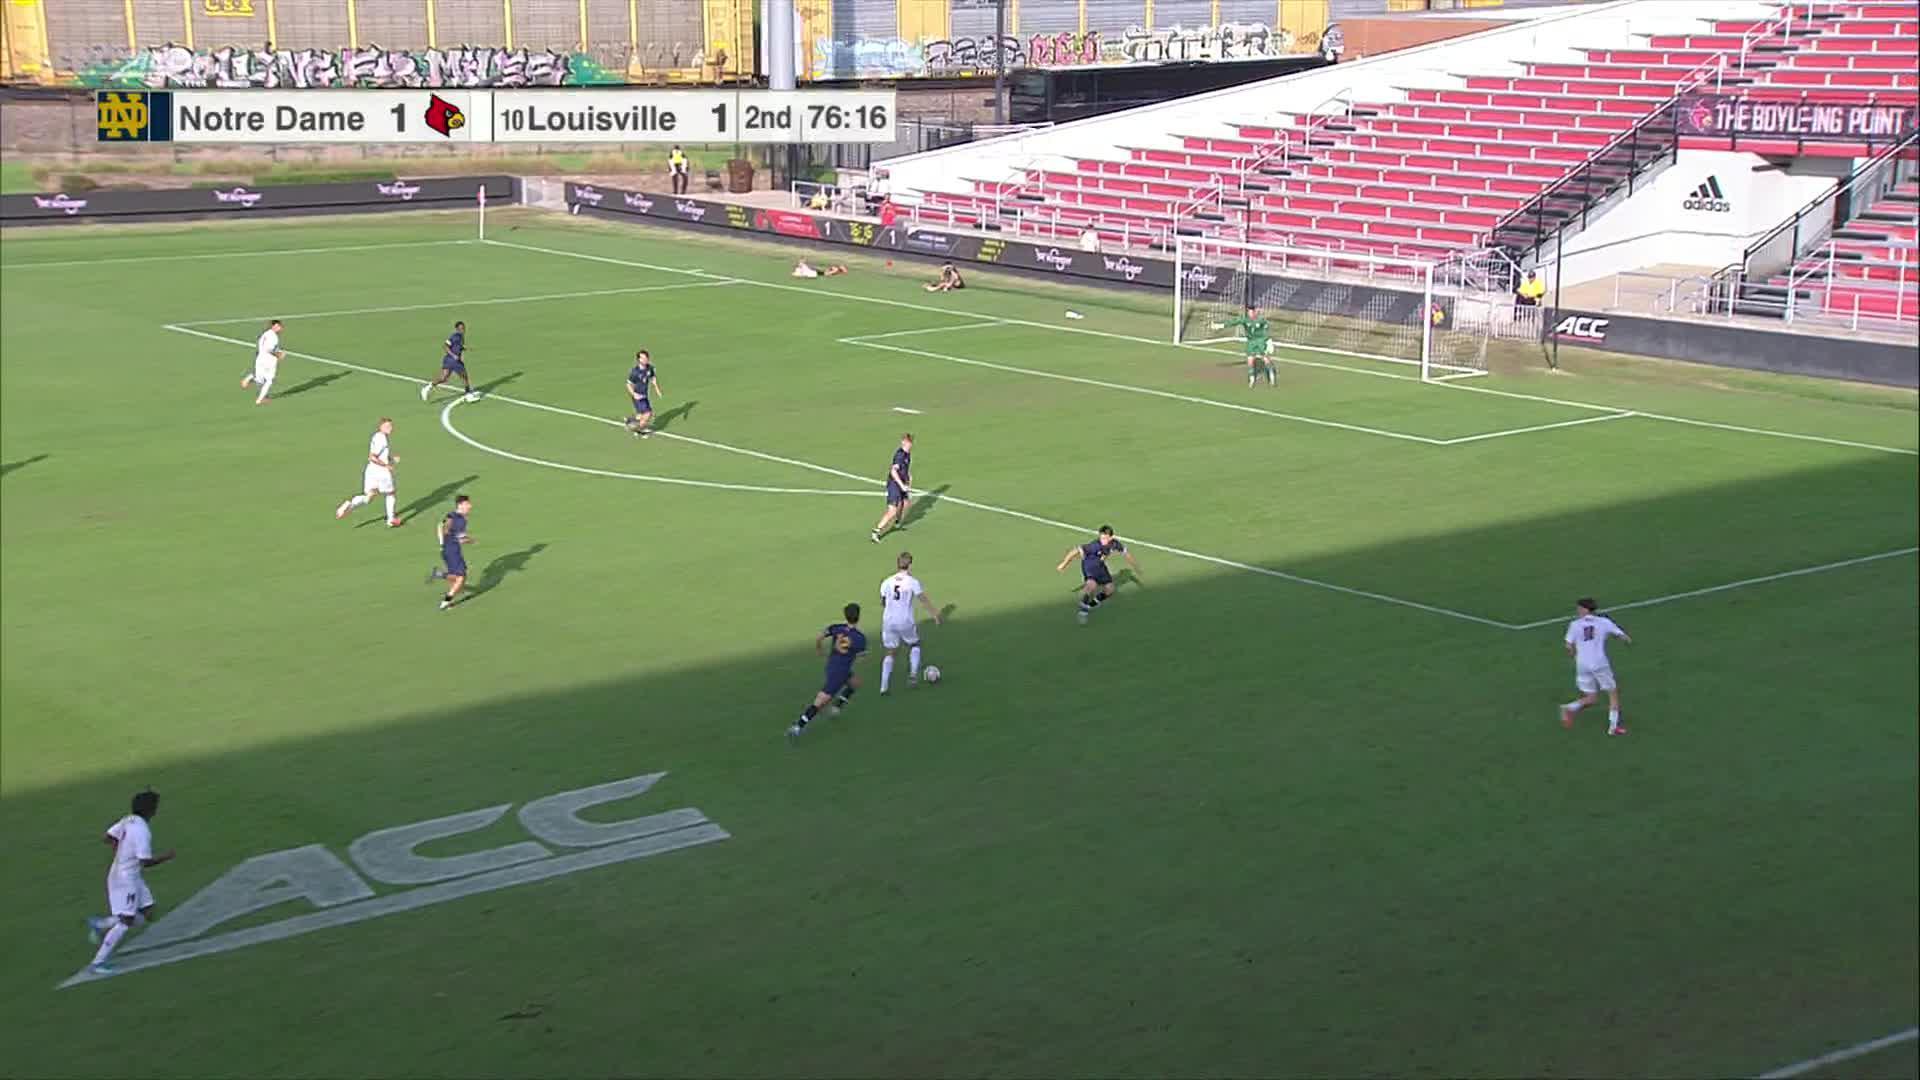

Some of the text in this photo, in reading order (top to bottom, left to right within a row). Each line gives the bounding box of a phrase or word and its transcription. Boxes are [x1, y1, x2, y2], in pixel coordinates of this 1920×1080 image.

[1716, 104, 1750, 131] THE
[1849, 108, 1904, 134] POINT
[1682, 198, 1731, 213] adidas
[1554, 315, 1609, 339] ACC
[893, 585, 901, 601] 5
[112, 770, 712, 957] ACC
